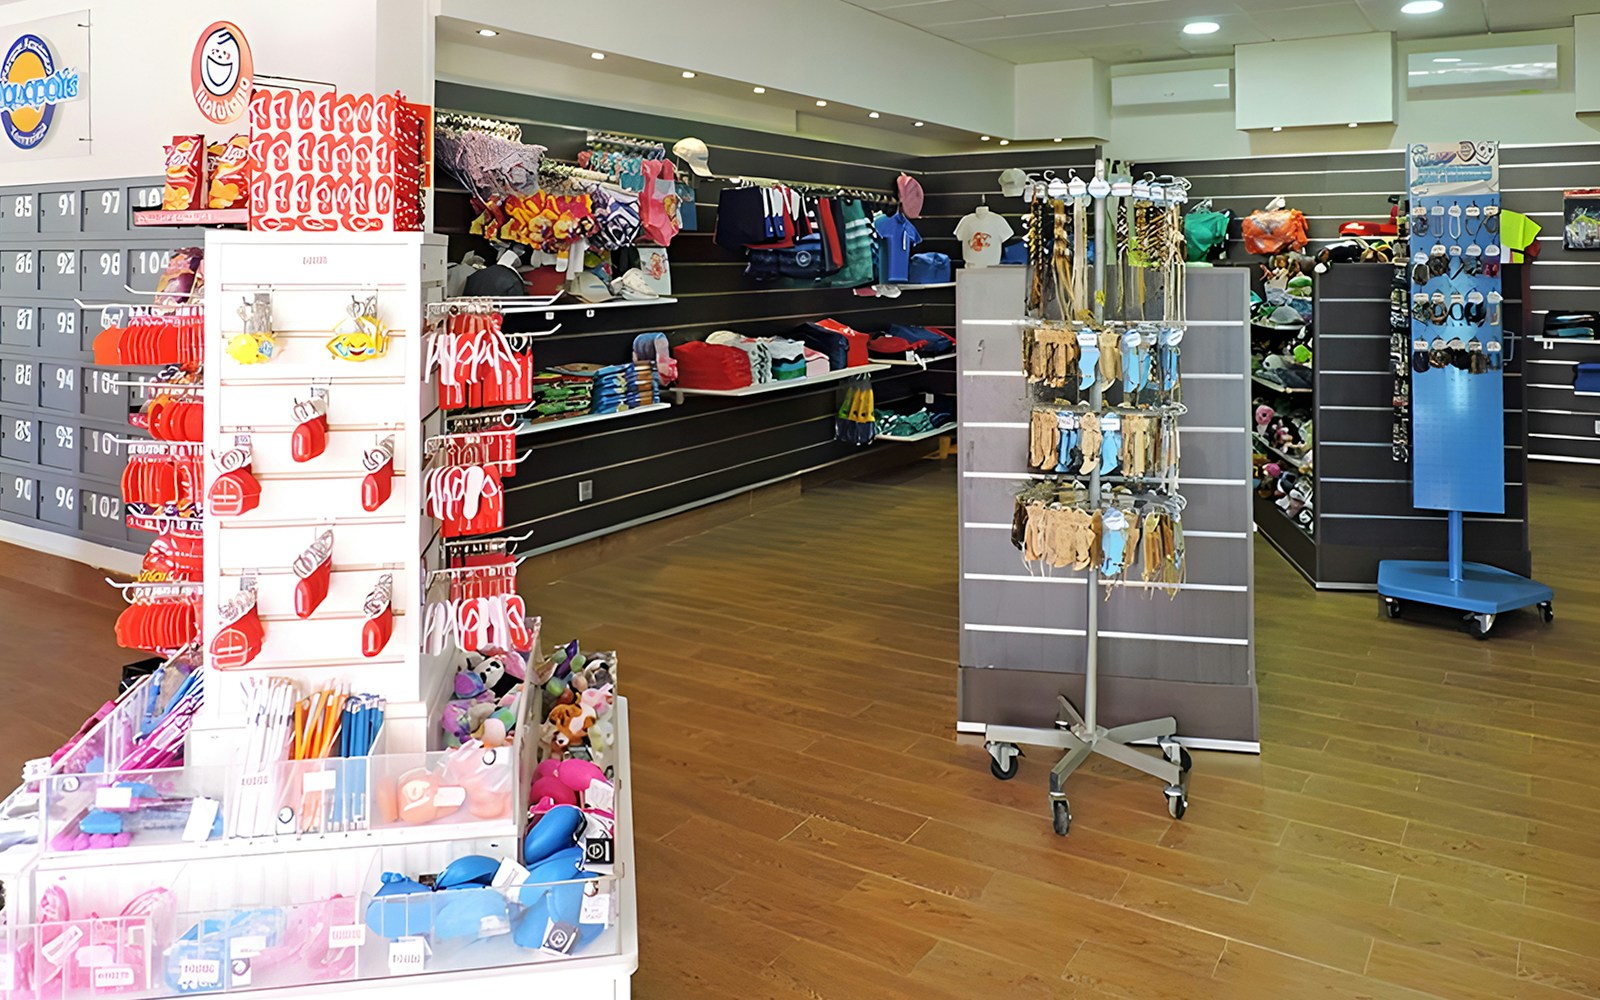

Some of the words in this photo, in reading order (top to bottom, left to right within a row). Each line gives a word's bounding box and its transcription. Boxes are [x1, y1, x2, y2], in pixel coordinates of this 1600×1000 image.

[14, 195, 32, 218] 85
[58, 193, 75, 216] 91
[101, 190, 120, 214] 97
[136, 187, 164, 208] 10
[56, 252, 74, 275] 92
[99, 252, 120, 276] 98
[56, 367, 73, 391] 94
[55, 486, 73, 510] 96
[91, 493, 118, 521] 102
